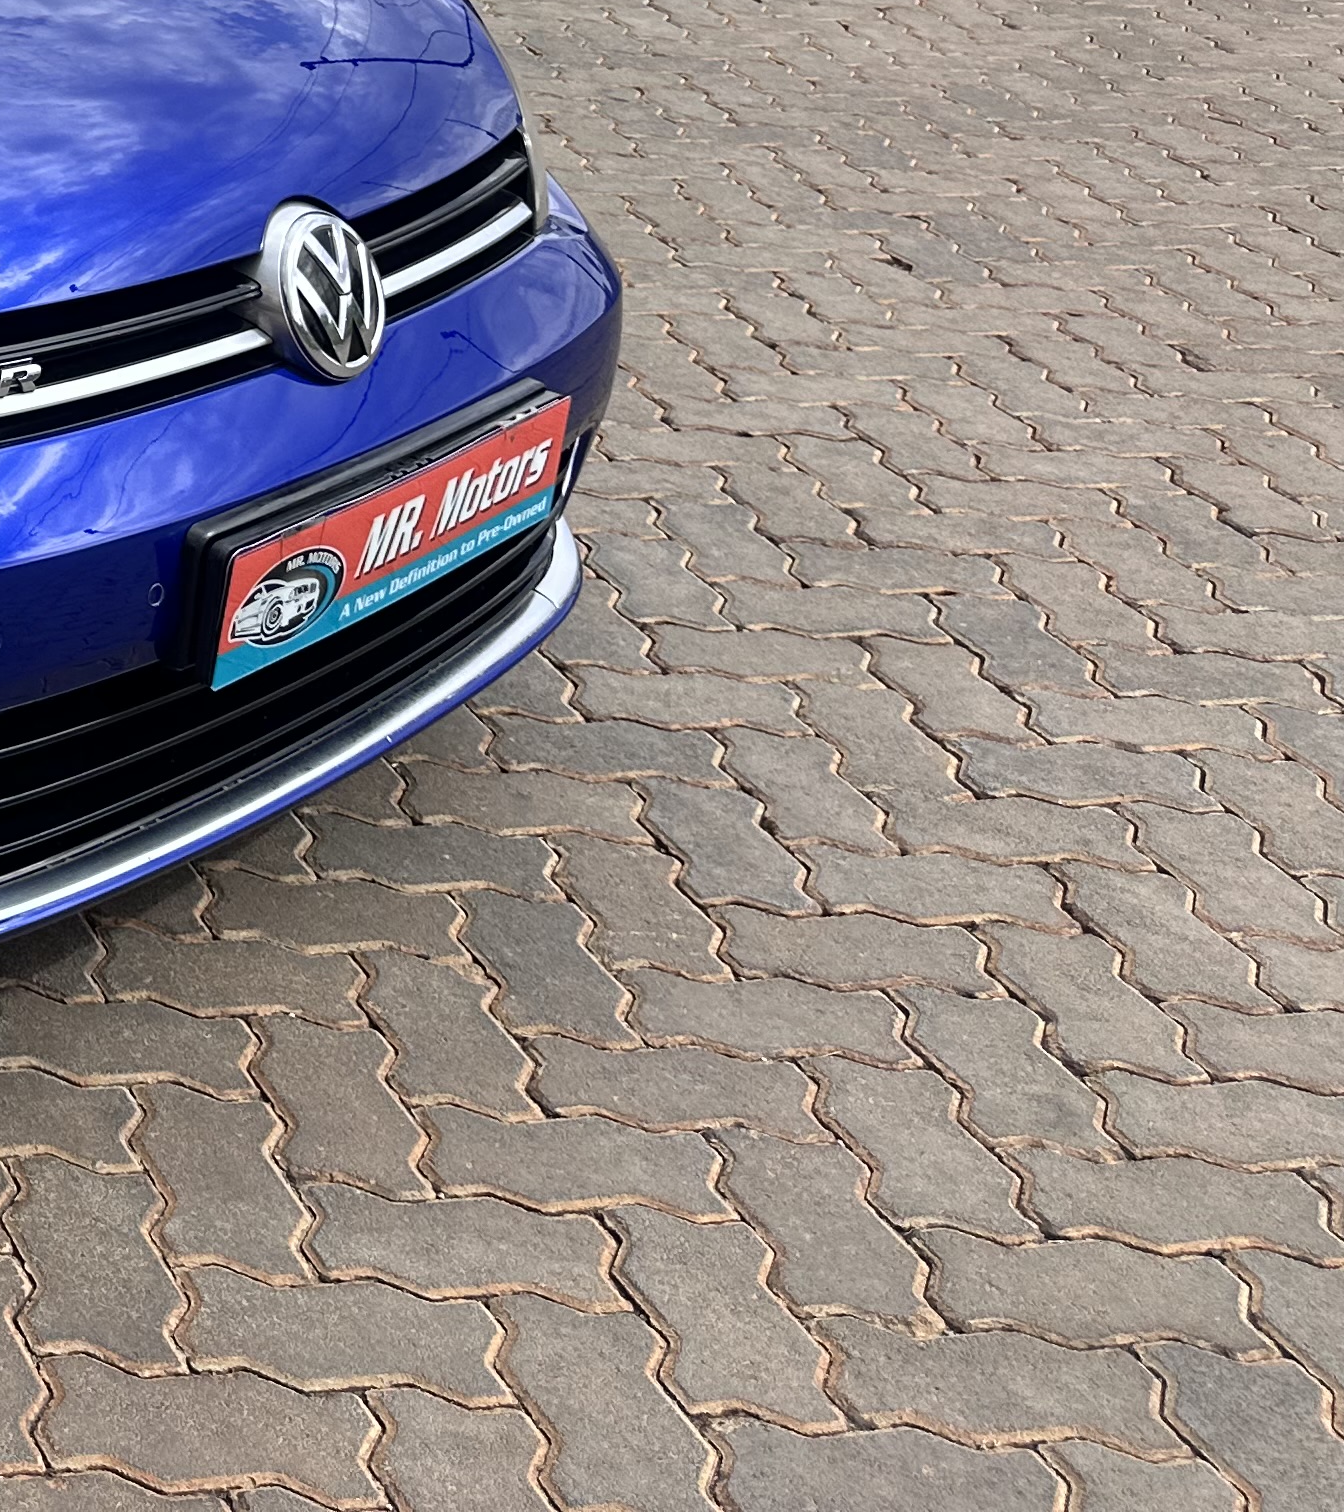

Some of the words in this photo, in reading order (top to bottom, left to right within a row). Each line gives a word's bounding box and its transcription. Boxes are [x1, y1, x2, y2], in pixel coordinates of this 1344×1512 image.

[285, 555, 305, 572] MR.
[306, 551, 342, 575] MOTORS
[337, 603, 351, 622] A
[353, 585, 386, 613] New
[388, 548, 458, 596] Definition
[460, 538, 475, 555] to
[477, 496, 548, 546] Pre-Owned
[353, 493, 426, 580] MR.
[428, 437, 554, 542] Motors
